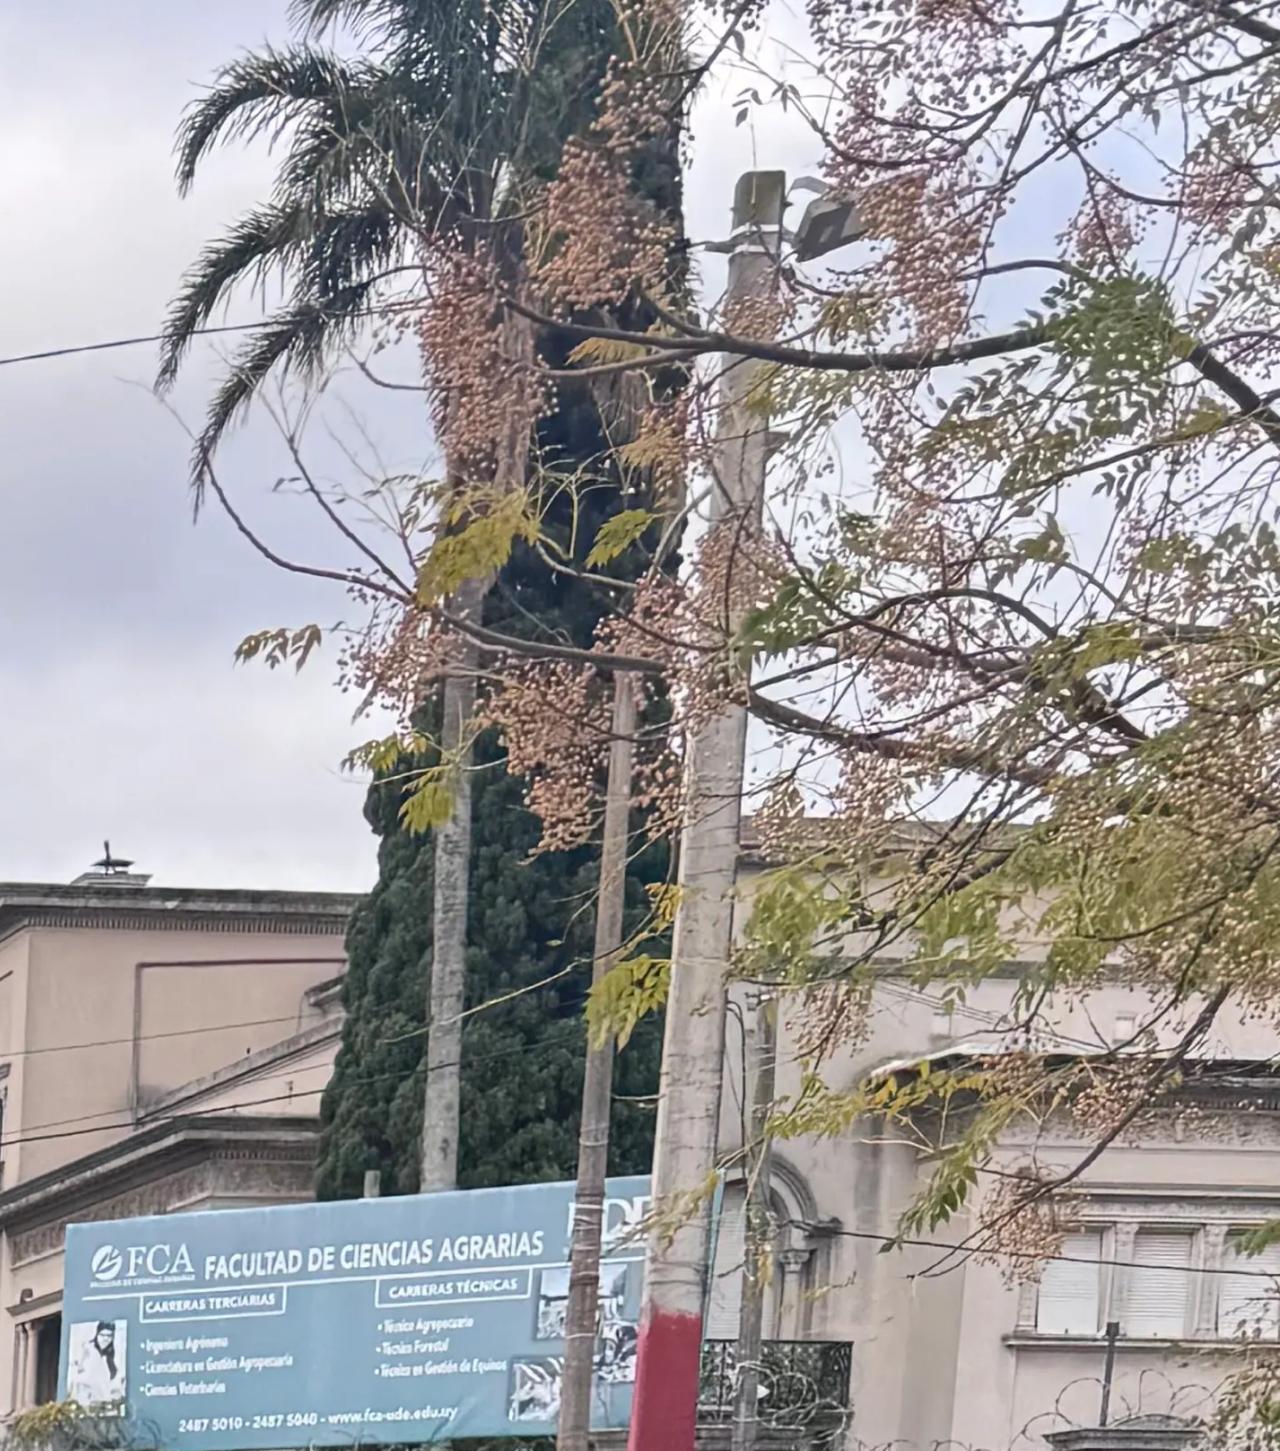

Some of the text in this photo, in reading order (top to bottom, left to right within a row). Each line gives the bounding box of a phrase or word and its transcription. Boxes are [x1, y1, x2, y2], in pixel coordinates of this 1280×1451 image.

[126, 1243, 195, 1277] FCA
[204, 1230, 545, 1280] FACULTAD DE CIENCIAS AGRARIAS
[388, 1277, 518, 1298] CARRERAS TÉCNICAS
[145, 1292, 276, 1314] CARRERAS TERCIARIAS
[212, 1416, 243, 1431] 5010
